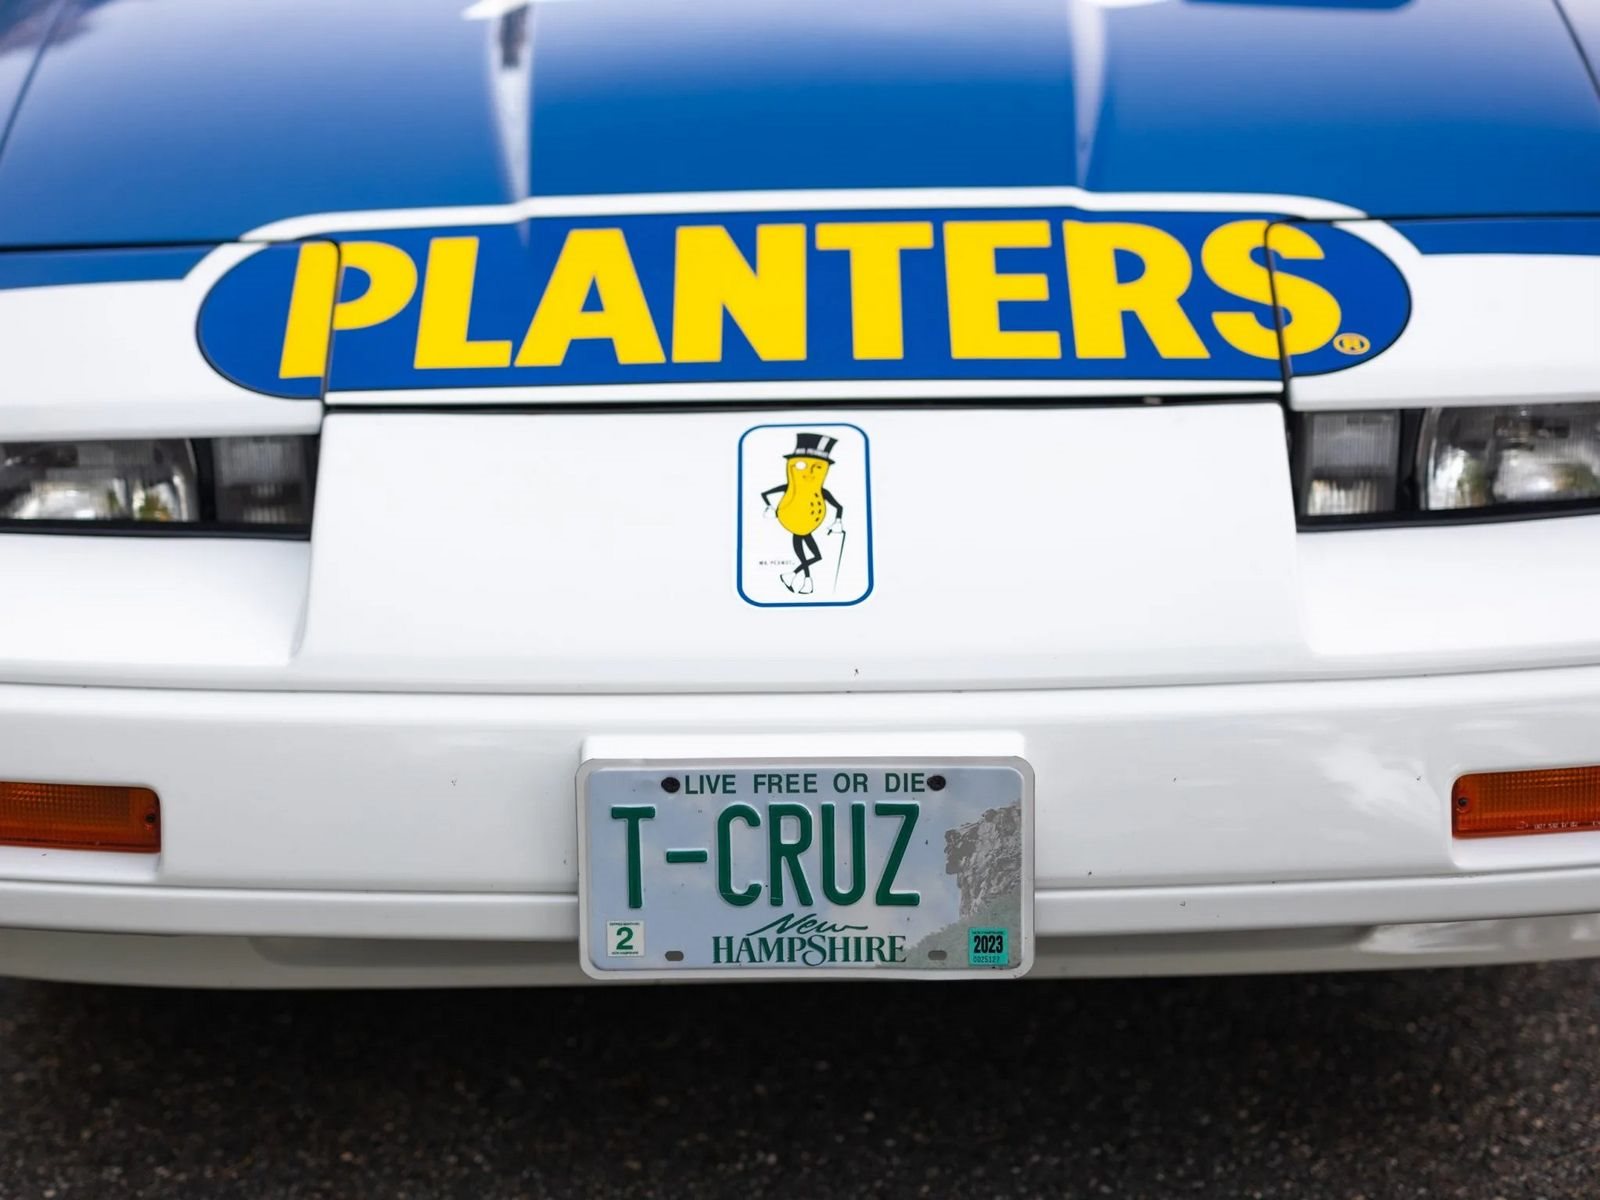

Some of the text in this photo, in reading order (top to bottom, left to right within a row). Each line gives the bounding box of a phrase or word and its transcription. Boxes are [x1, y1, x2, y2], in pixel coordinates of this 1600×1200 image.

[278, 219, 1342, 379] PLANTERS
[685, 772, 925, 795] LIVE FREE OR DIE
[611, 802, 921, 909] T-CRUZ
[746, 913, 868, 935] New
[616, 926, 634, 950] 2
[712, 934, 907, 966] HAMPSHIRE
[973, 934, 1004, 954] 2023
